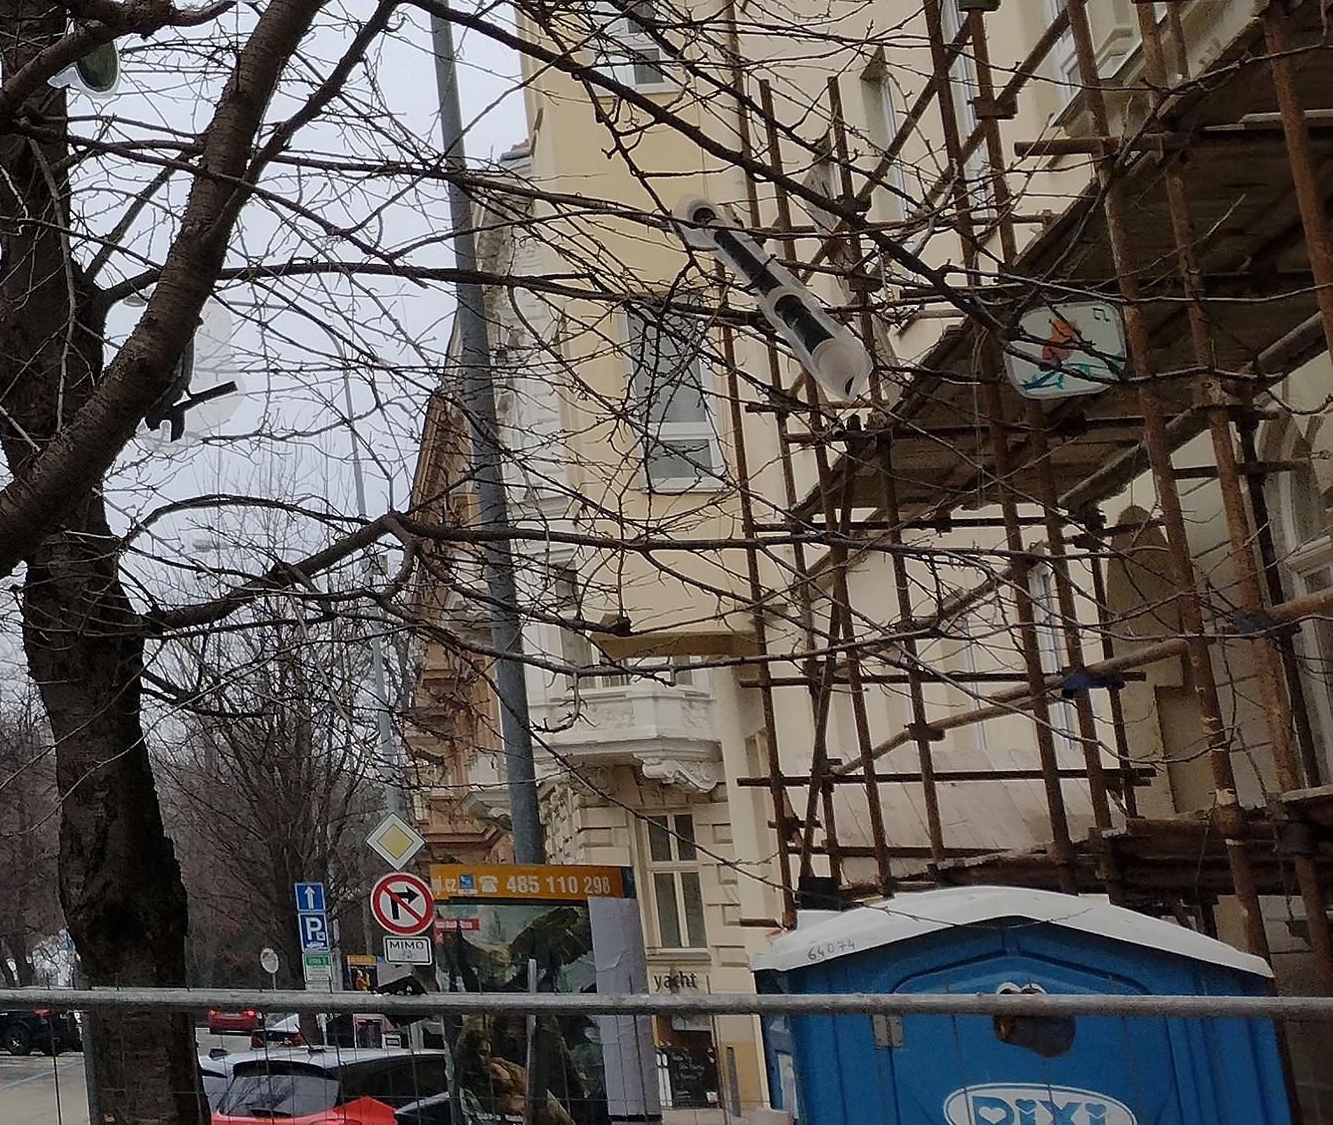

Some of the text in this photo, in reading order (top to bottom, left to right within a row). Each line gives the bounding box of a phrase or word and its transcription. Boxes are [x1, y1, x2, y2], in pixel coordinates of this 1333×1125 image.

[506, 876, 540, 894] 485
[546, 876, 578, 894] 110
[584, 877, 611, 894] 298
[305, 916, 323, 941] P
[389, 941, 424, 950] MIMO
[653, 970, 699, 992] yacht
